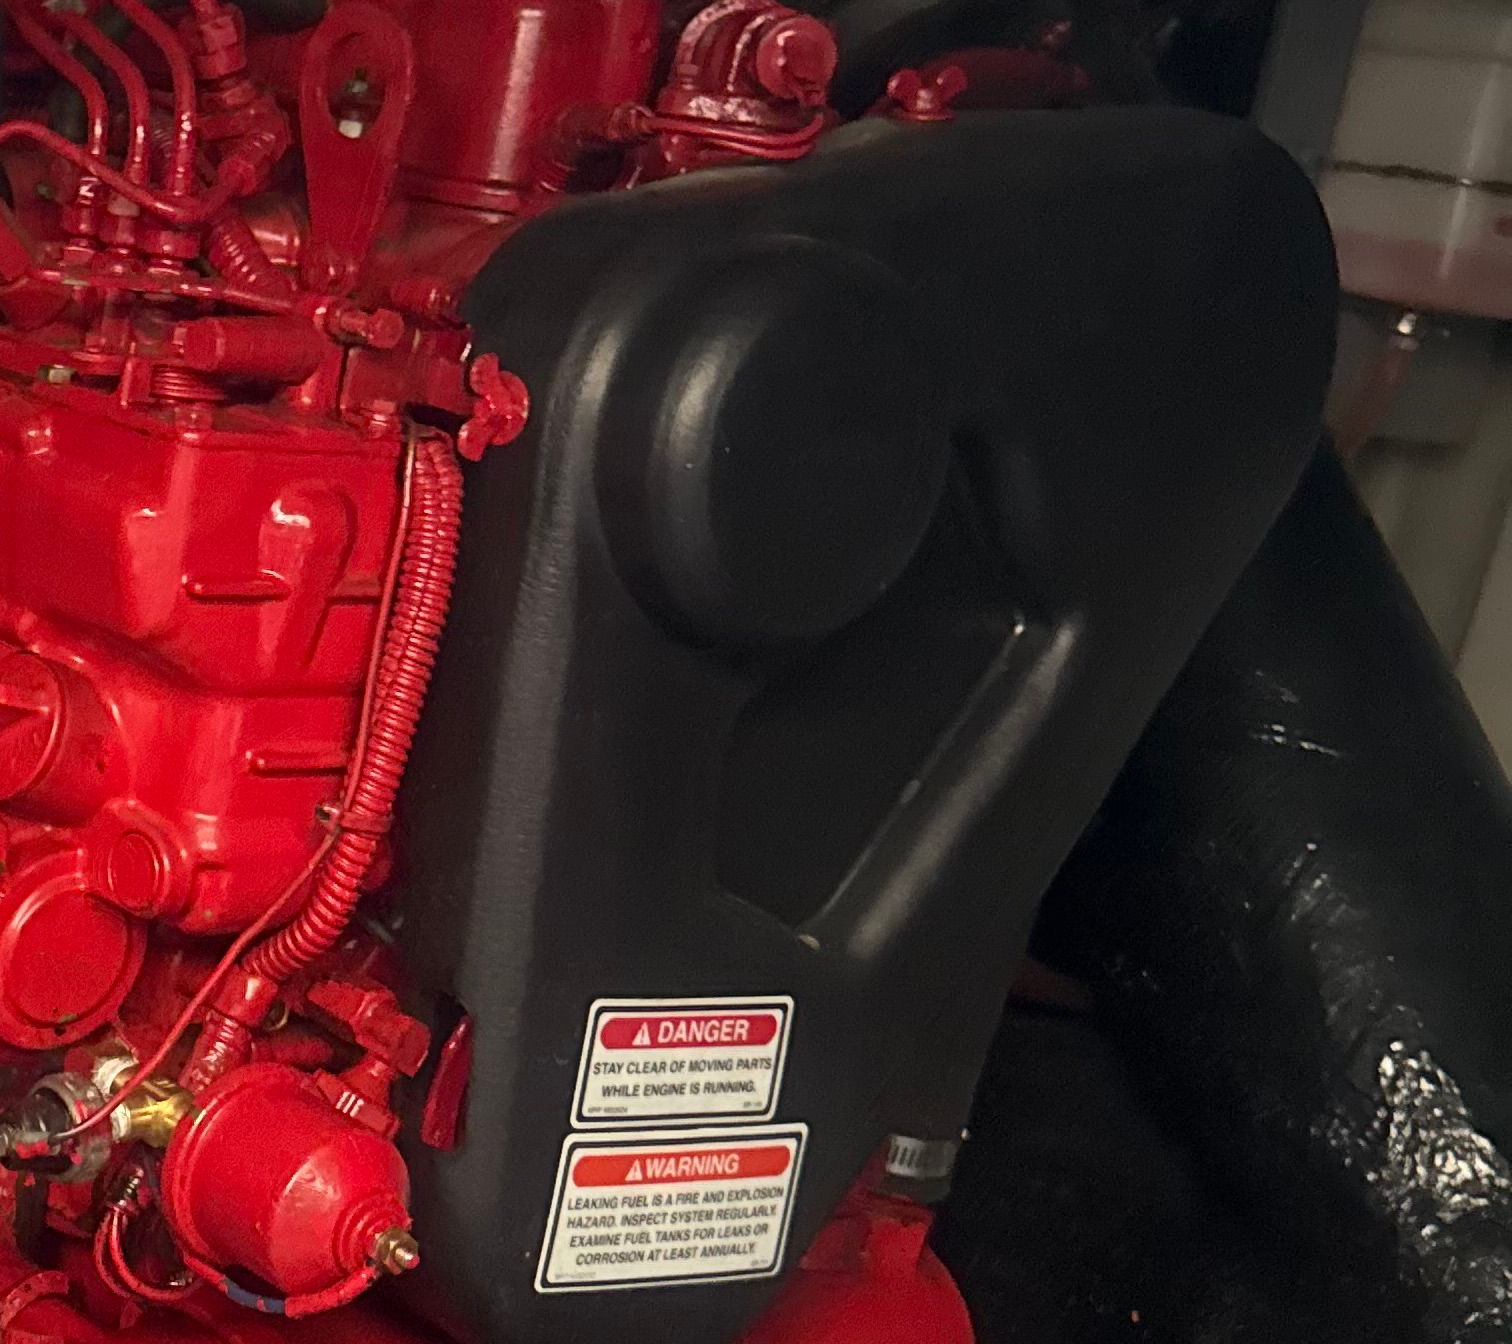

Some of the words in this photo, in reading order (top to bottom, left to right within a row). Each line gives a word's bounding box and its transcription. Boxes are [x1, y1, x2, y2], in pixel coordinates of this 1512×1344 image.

[657, 1019, 750, 1043] DANGER
[593, 1062, 624, 1075] STAY
[626, 1061, 667, 1074] CLEAR
[669, 1060, 686, 1073] OF
[688, 1059, 733, 1072] MOVING
[737, 1057, 772, 1070] PARTS
[602, 1084, 640, 1097] WHILE
[643, 1082, 686, 1096] ENGINE
[690, 1082, 700, 1094] IS
[703, 1080, 756, 1094] RUNNING.
[645, 1153, 740, 1178] WARNING
[567, 1197, 618, 1210] LEAKING
[621, 1195, 648, 1208] FUEL
[652, 1194, 663, 1206] IS
[664, 1193, 673, 1205] A
[675, 1192, 700, 1205] FIRE
[702, 1190, 725, 1203] AND
[727, 1186, 784, 1201] EXPLOSION
[567, 1215, 616, 1229] HAZARD.
[620, 1212, 669, 1226] INSPECT
[670, 1209, 714, 1223] SYSTEM
[569, 1234, 622, 1247] EXAMINE
[624, 1232, 651, 1244] FUEL
[656, 1229, 691, 1242] TANKS
[693, 1227, 715, 1240] FOR
[717, 1224, 751, 1238] LEAKS
[753, 1223, 769, 1235] OR
[576, 1251, 645, 1265] CORROSION
[647, 1249, 662, 1261] AT
[663, 1246, 698, 1260] LEAST
